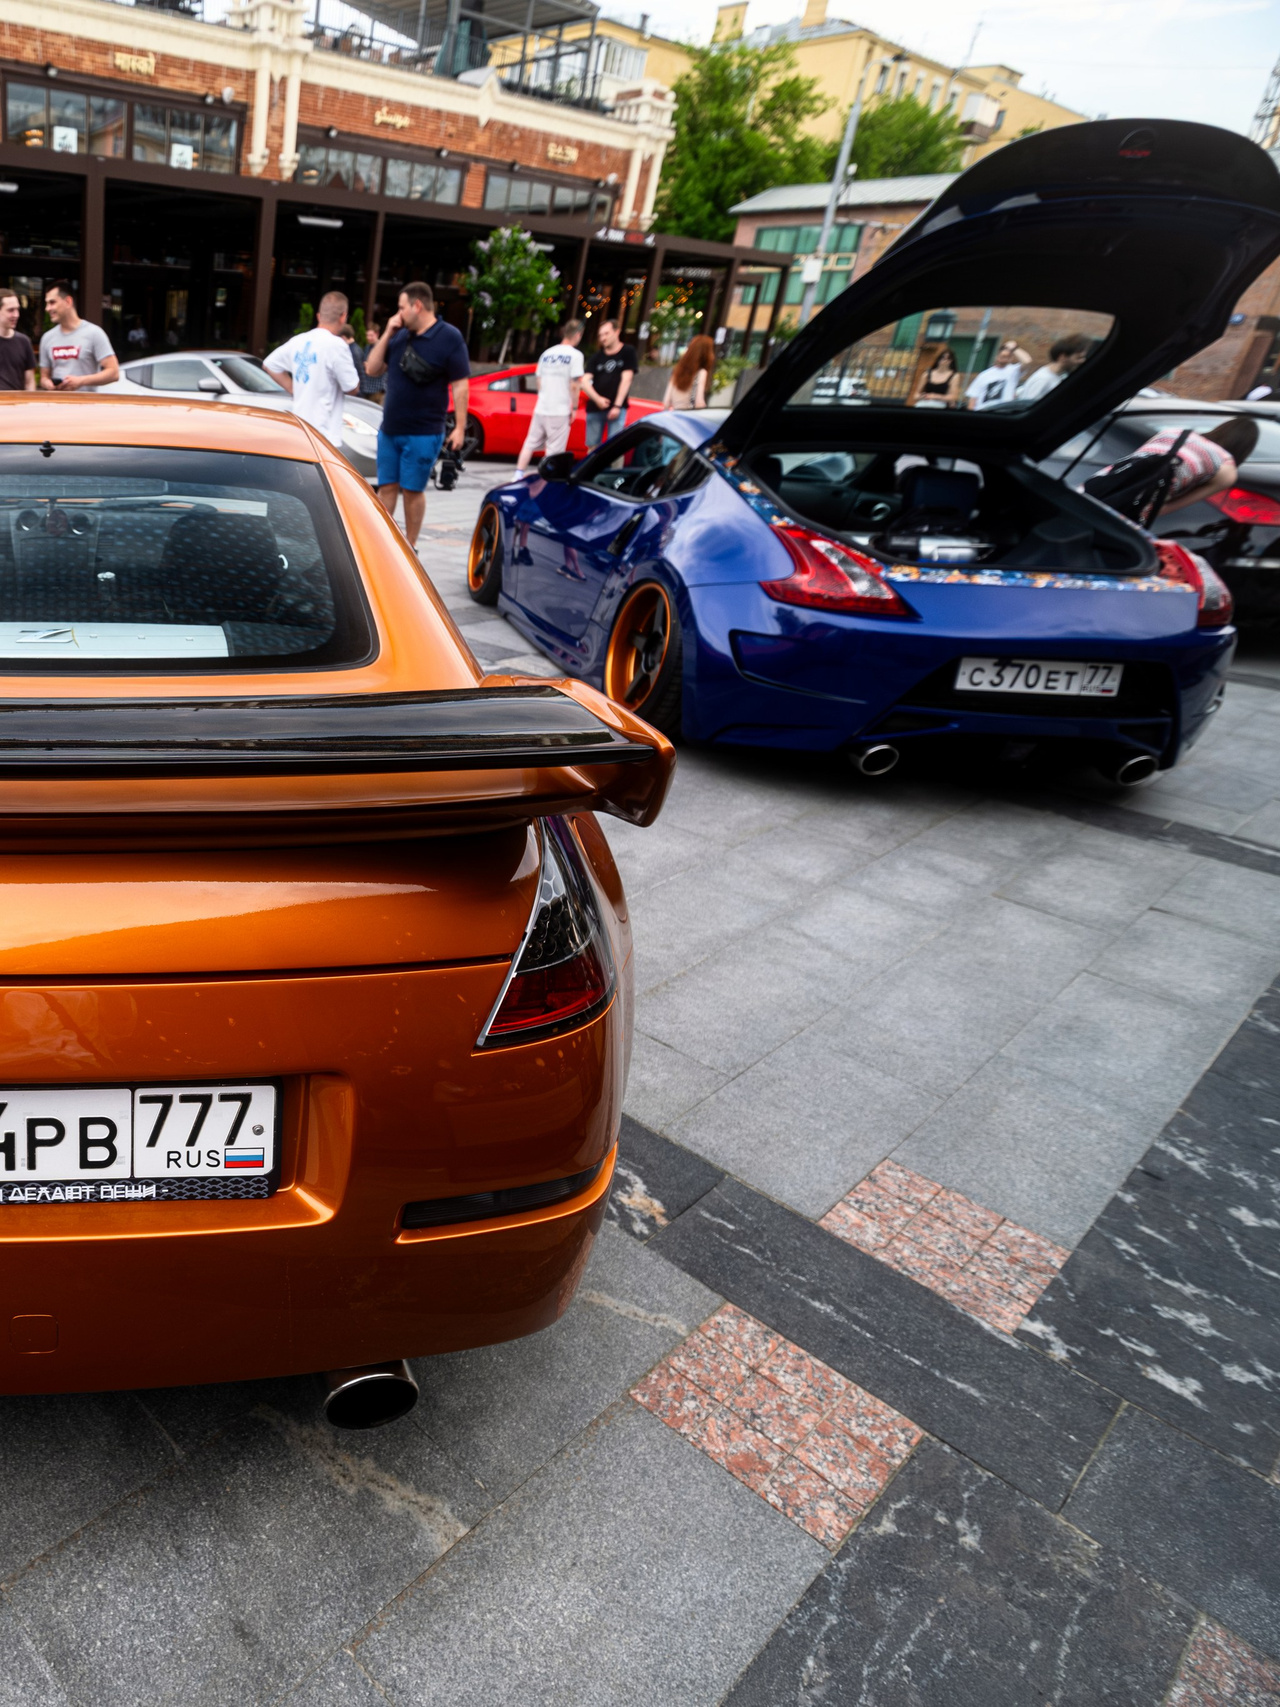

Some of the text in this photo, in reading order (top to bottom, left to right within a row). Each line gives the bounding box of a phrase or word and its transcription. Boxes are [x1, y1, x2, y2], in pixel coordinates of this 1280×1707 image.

[1086, 665, 1114, 685] 77
[138, 1091, 254, 1148] 777
[166, 1150, 221, 1169] RUS
[8, 1187, 95, 1201] ДЕЛАЮТ
[100, 1185, 156, 1199] ВЕЩИ
